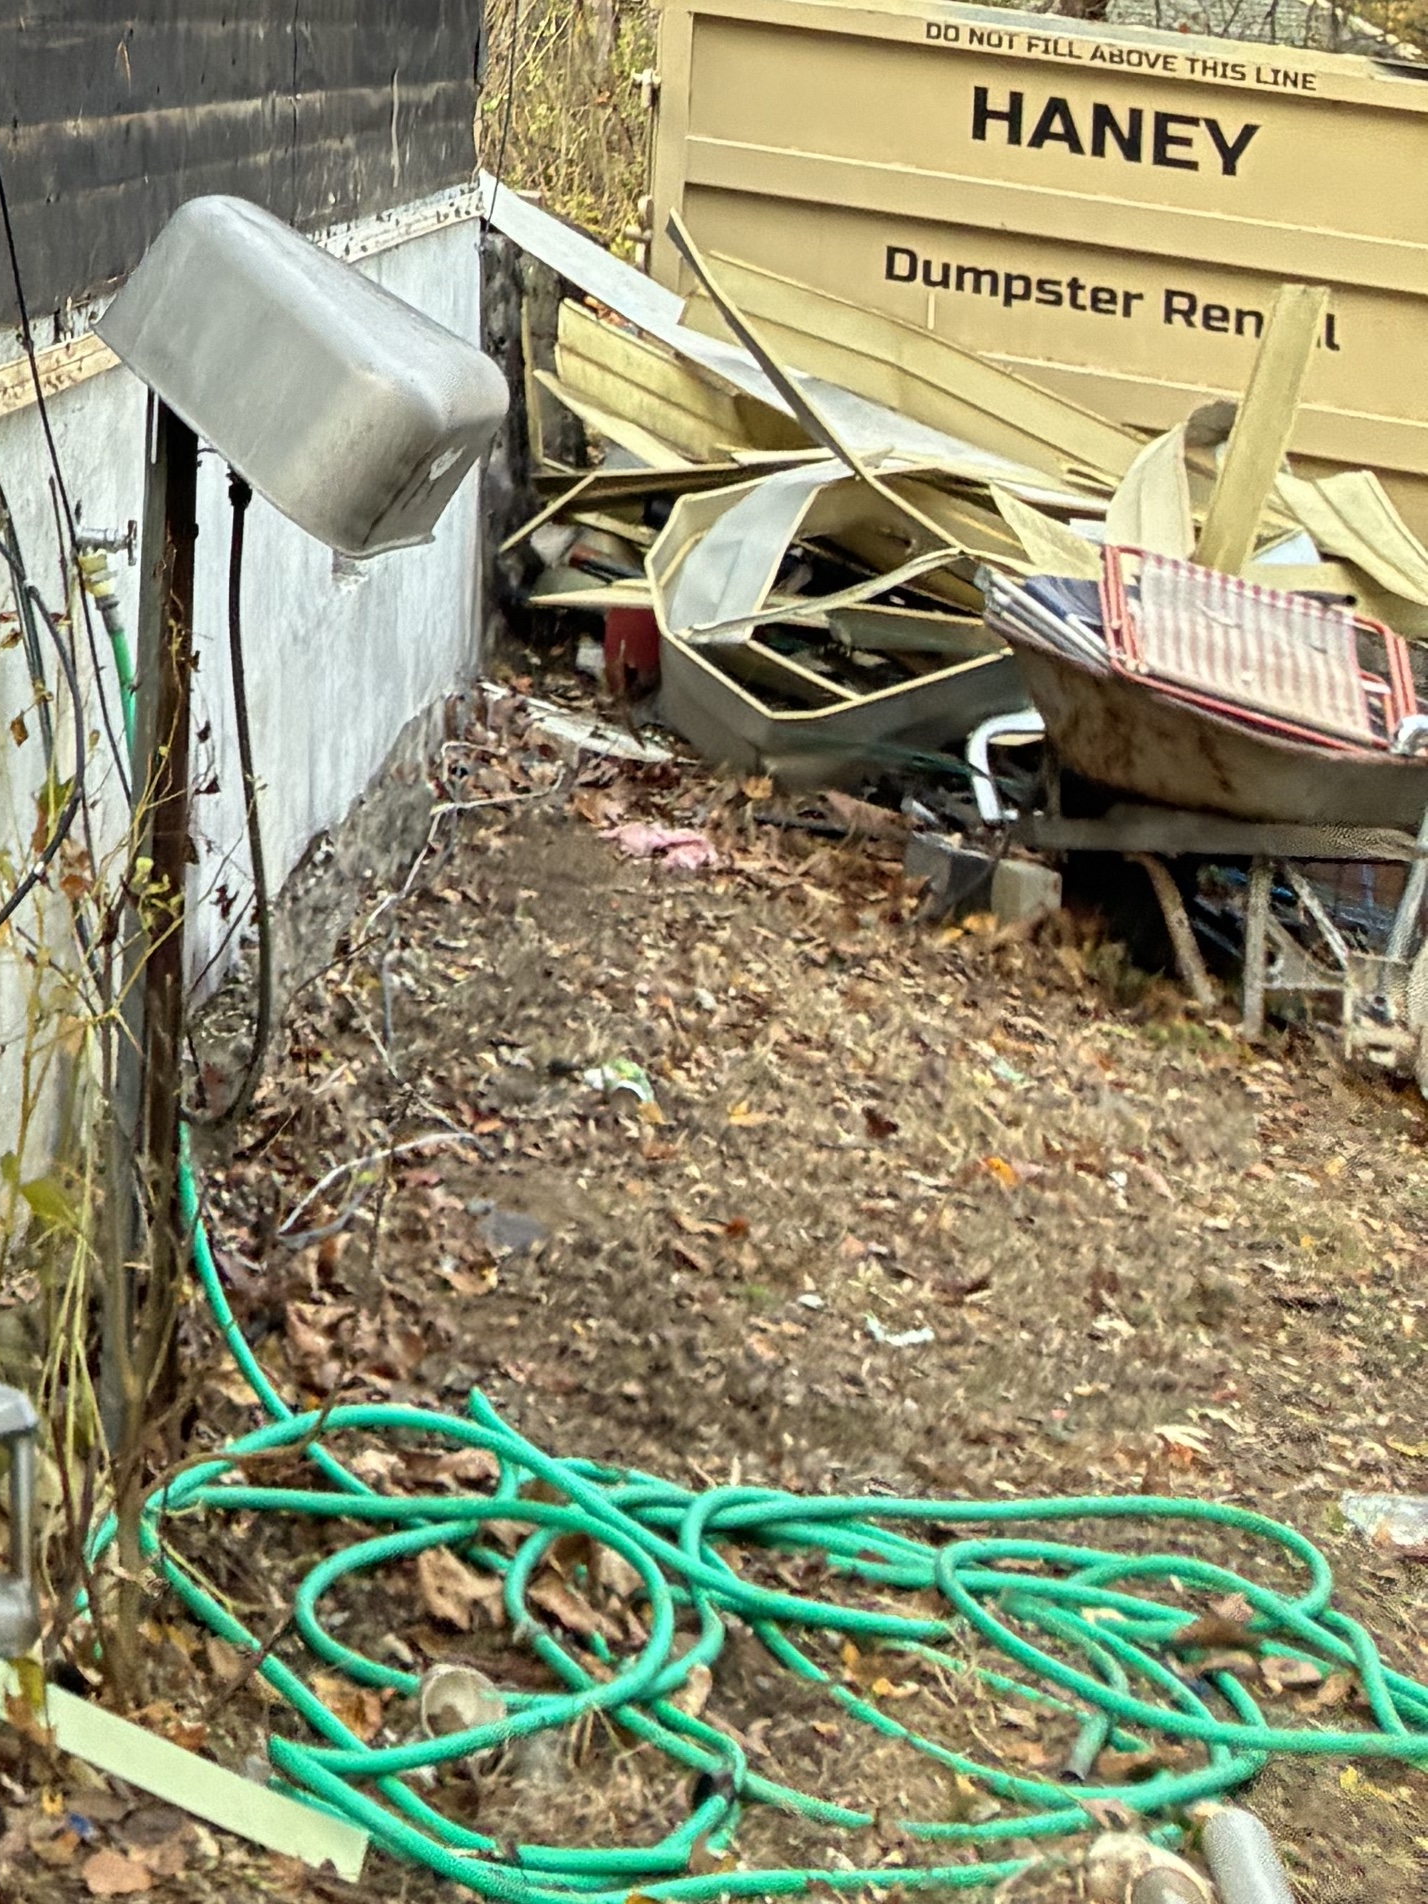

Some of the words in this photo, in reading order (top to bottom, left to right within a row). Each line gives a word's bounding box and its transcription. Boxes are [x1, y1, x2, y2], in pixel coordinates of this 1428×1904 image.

[926, 22, 960, 42] DO
[969, 28, 1019, 50] NOT
[1027, 36, 1083, 60] FILL
[1090, 45, 1178, 72] ABOVE
[1185, 57, 1247, 81] THIS
[1255, 66, 1317, 91] LINE
[971, 86, 1262, 177] HANEY
[885, 245, 1145, 318] Dumpster
[1163, 288, 1340, 351] Renl
